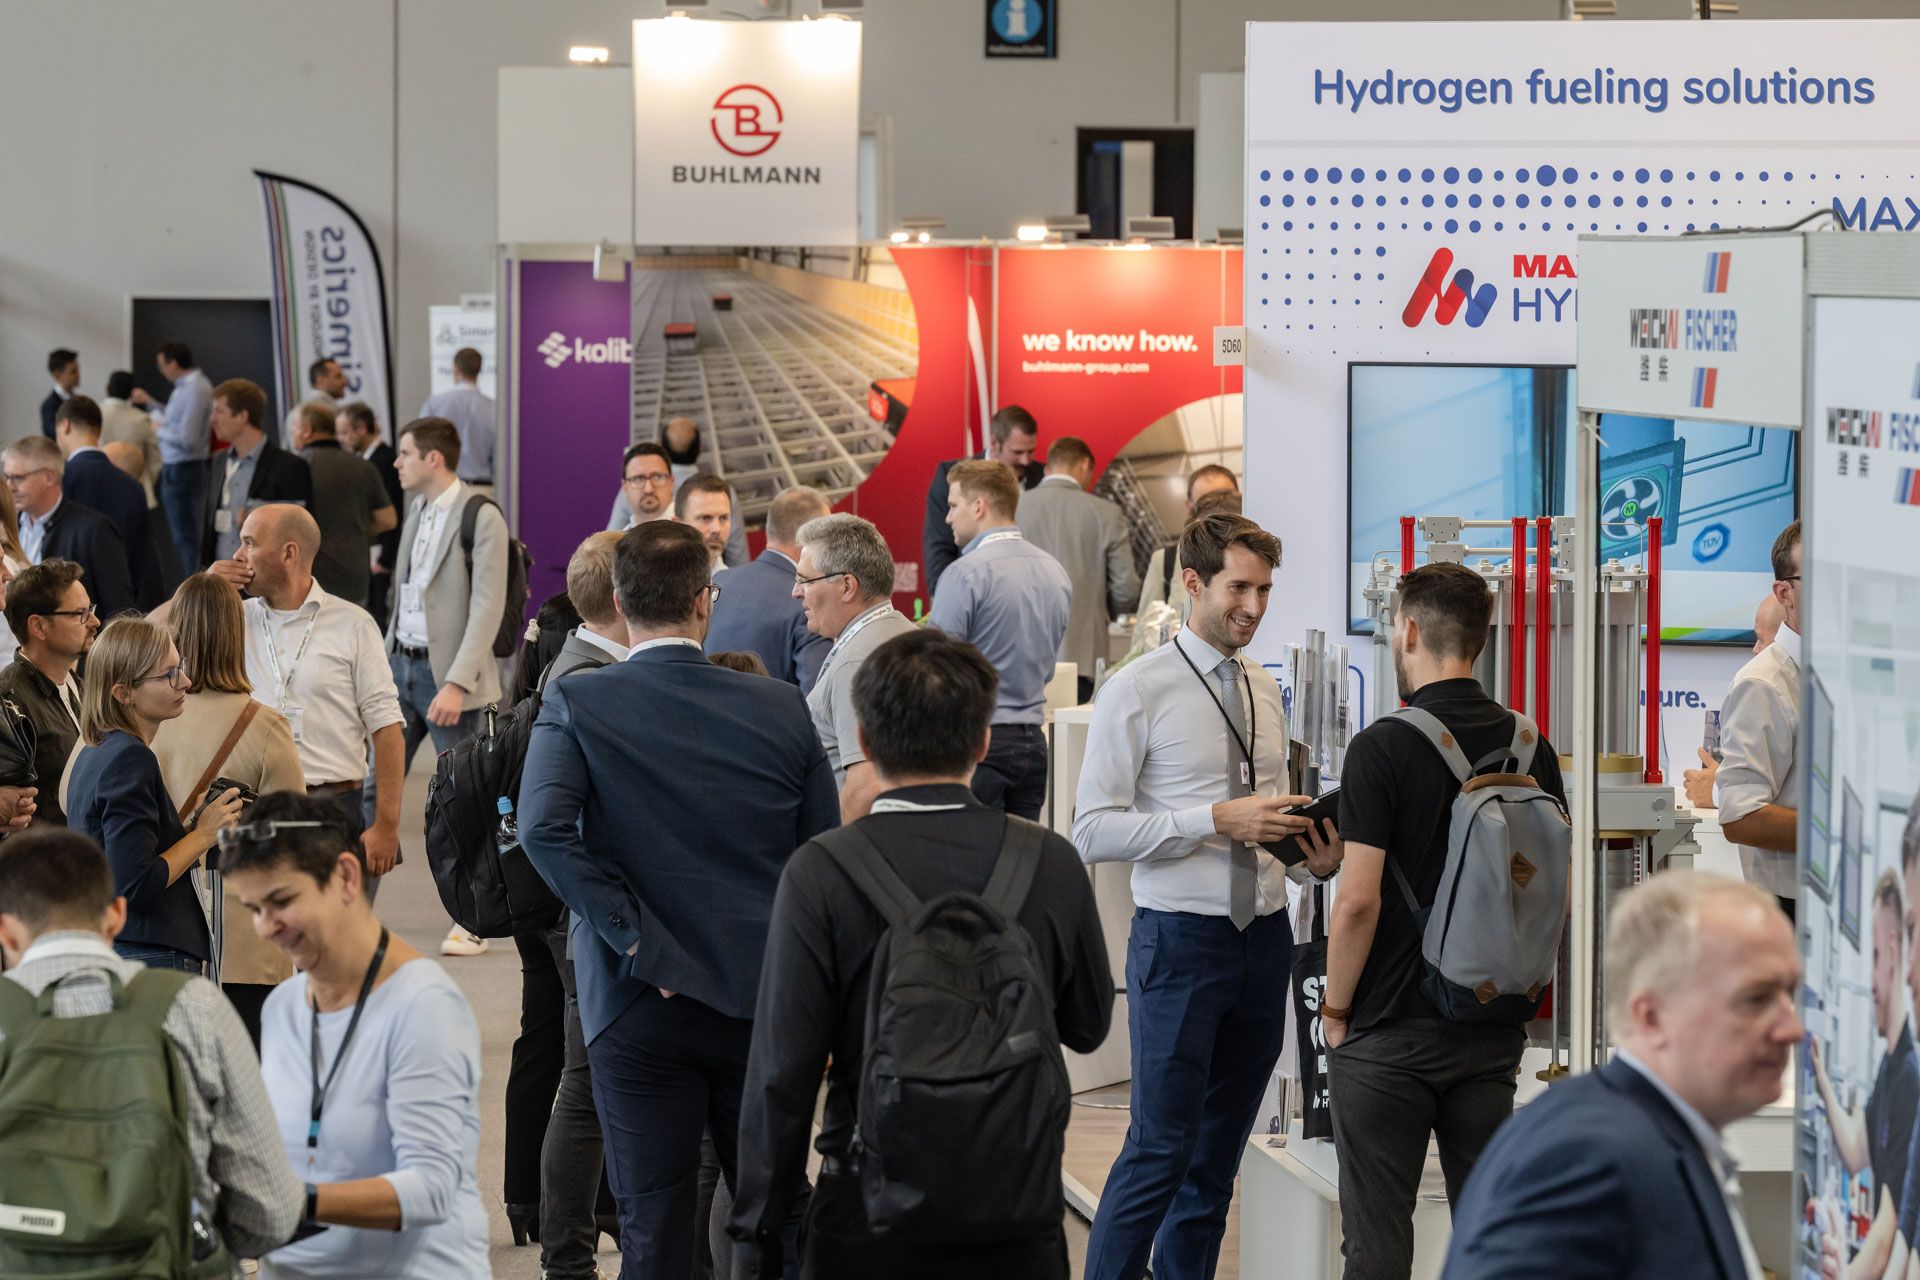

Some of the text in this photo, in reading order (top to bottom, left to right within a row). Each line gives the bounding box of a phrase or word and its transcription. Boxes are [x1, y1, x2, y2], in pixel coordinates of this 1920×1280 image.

[1314, 67, 1875, 114] Hydrogen fueling solutions
[672, 165, 821, 184] BUHLMANN
[1513, 254, 1578, 279] MA
[1513, 287, 1578, 322] HY
[1022, 329, 1199, 352] we know how.
[1629, 308, 1738, 352] WEICHAI FISCHER
[1222, 339, 1242, 353] 5D60
[1022, 360, 1150, 375] buhlmann-group.com
[1702, 535, 1722, 549] TÜV
